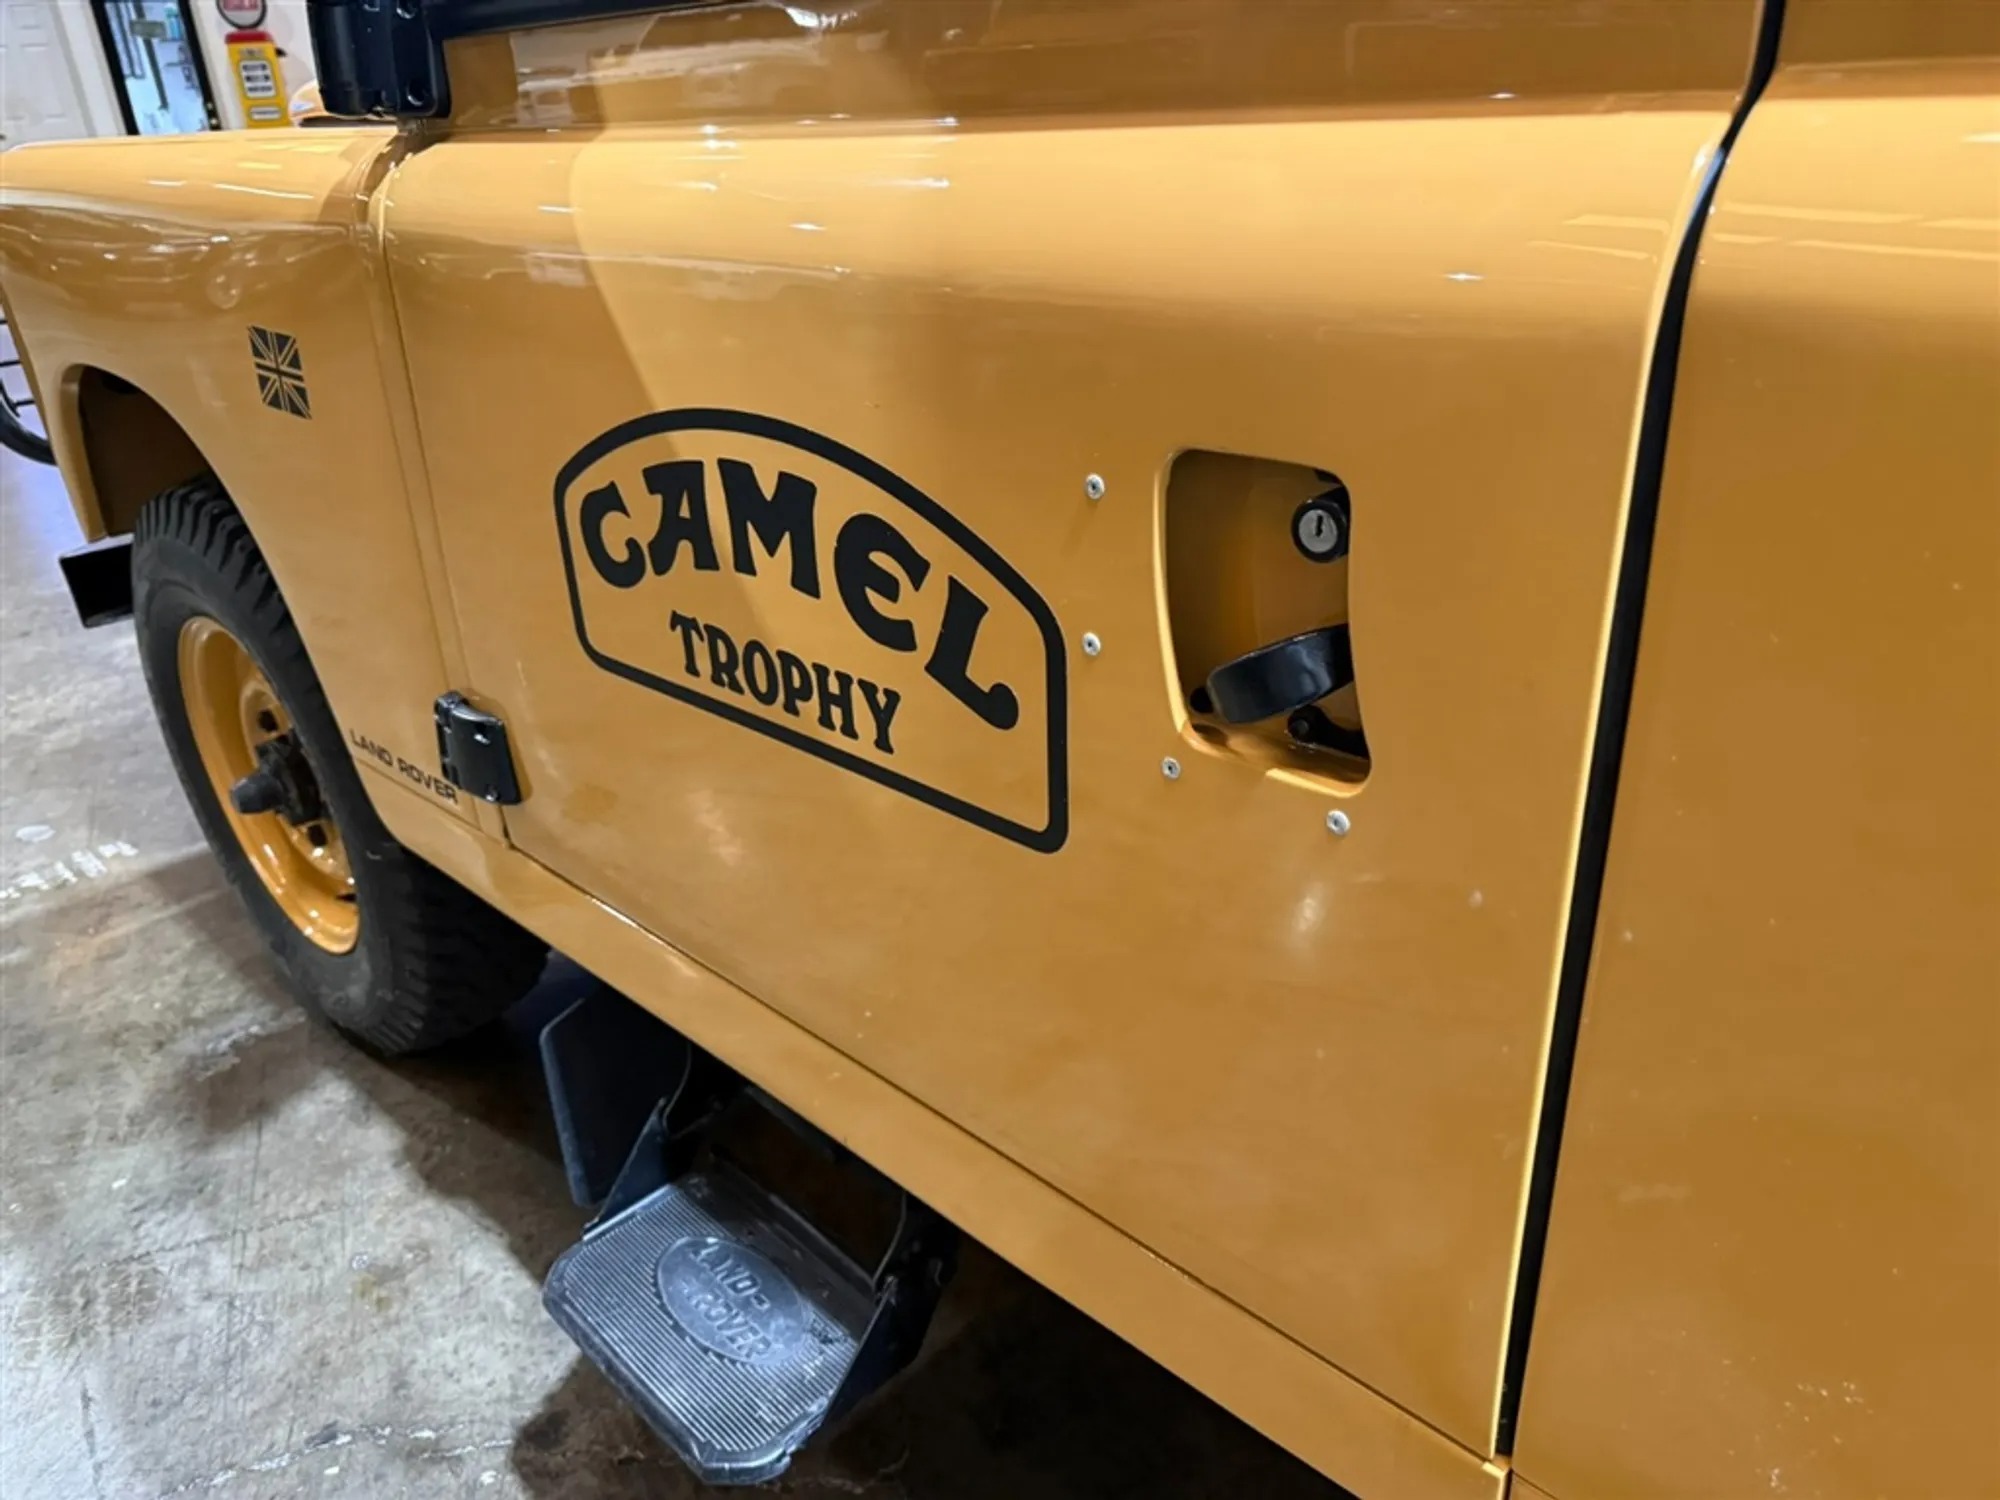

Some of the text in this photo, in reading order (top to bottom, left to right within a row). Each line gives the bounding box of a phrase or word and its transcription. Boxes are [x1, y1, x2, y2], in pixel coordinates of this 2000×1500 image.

[580, 457, 1019, 730] CAMEL
[670, 609, 901, 754] TROPHY
[349, 728, 459, 804] LAND ROVER
